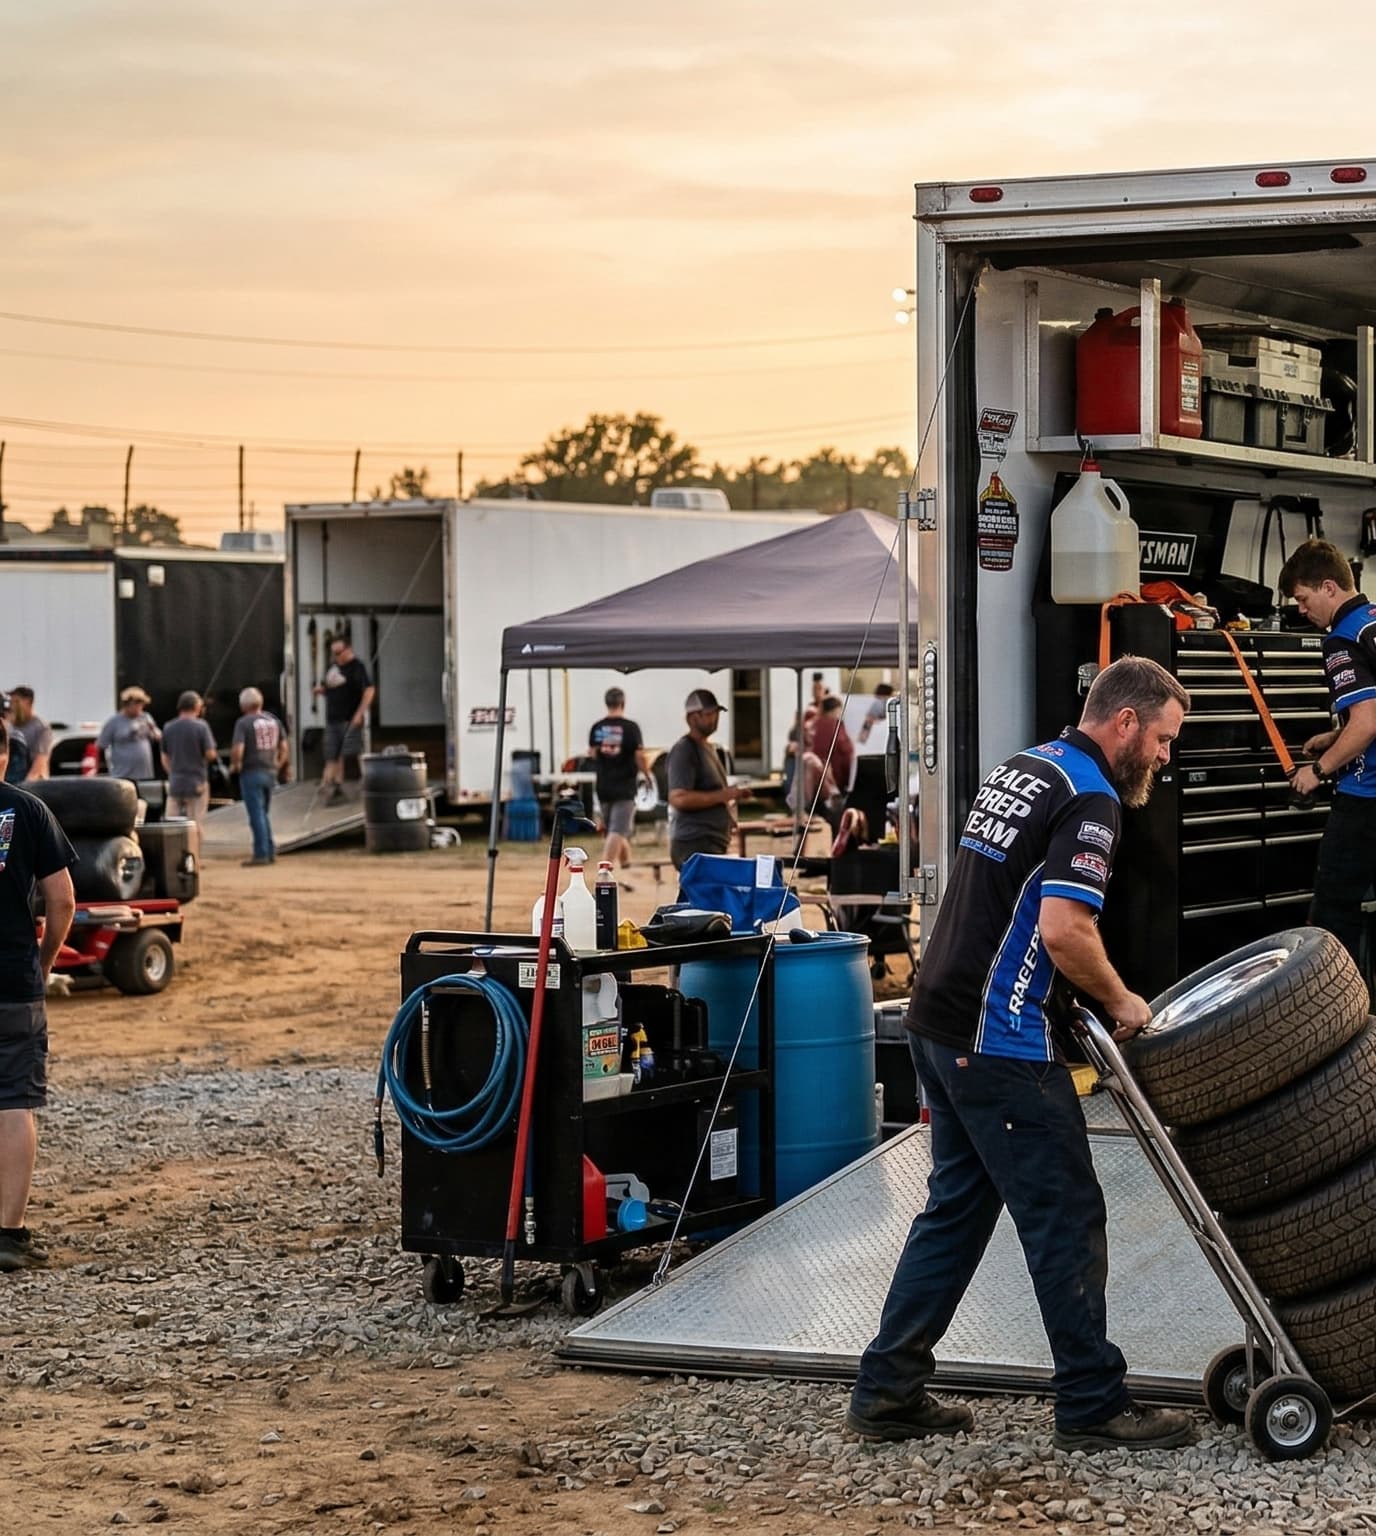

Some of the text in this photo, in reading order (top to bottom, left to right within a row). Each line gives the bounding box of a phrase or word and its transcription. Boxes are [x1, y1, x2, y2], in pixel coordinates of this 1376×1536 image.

[984, 765, 1052, 801] RACE
[973, 786, 1033, 819] PREP
[964, 811, 1020, 849] EAM
